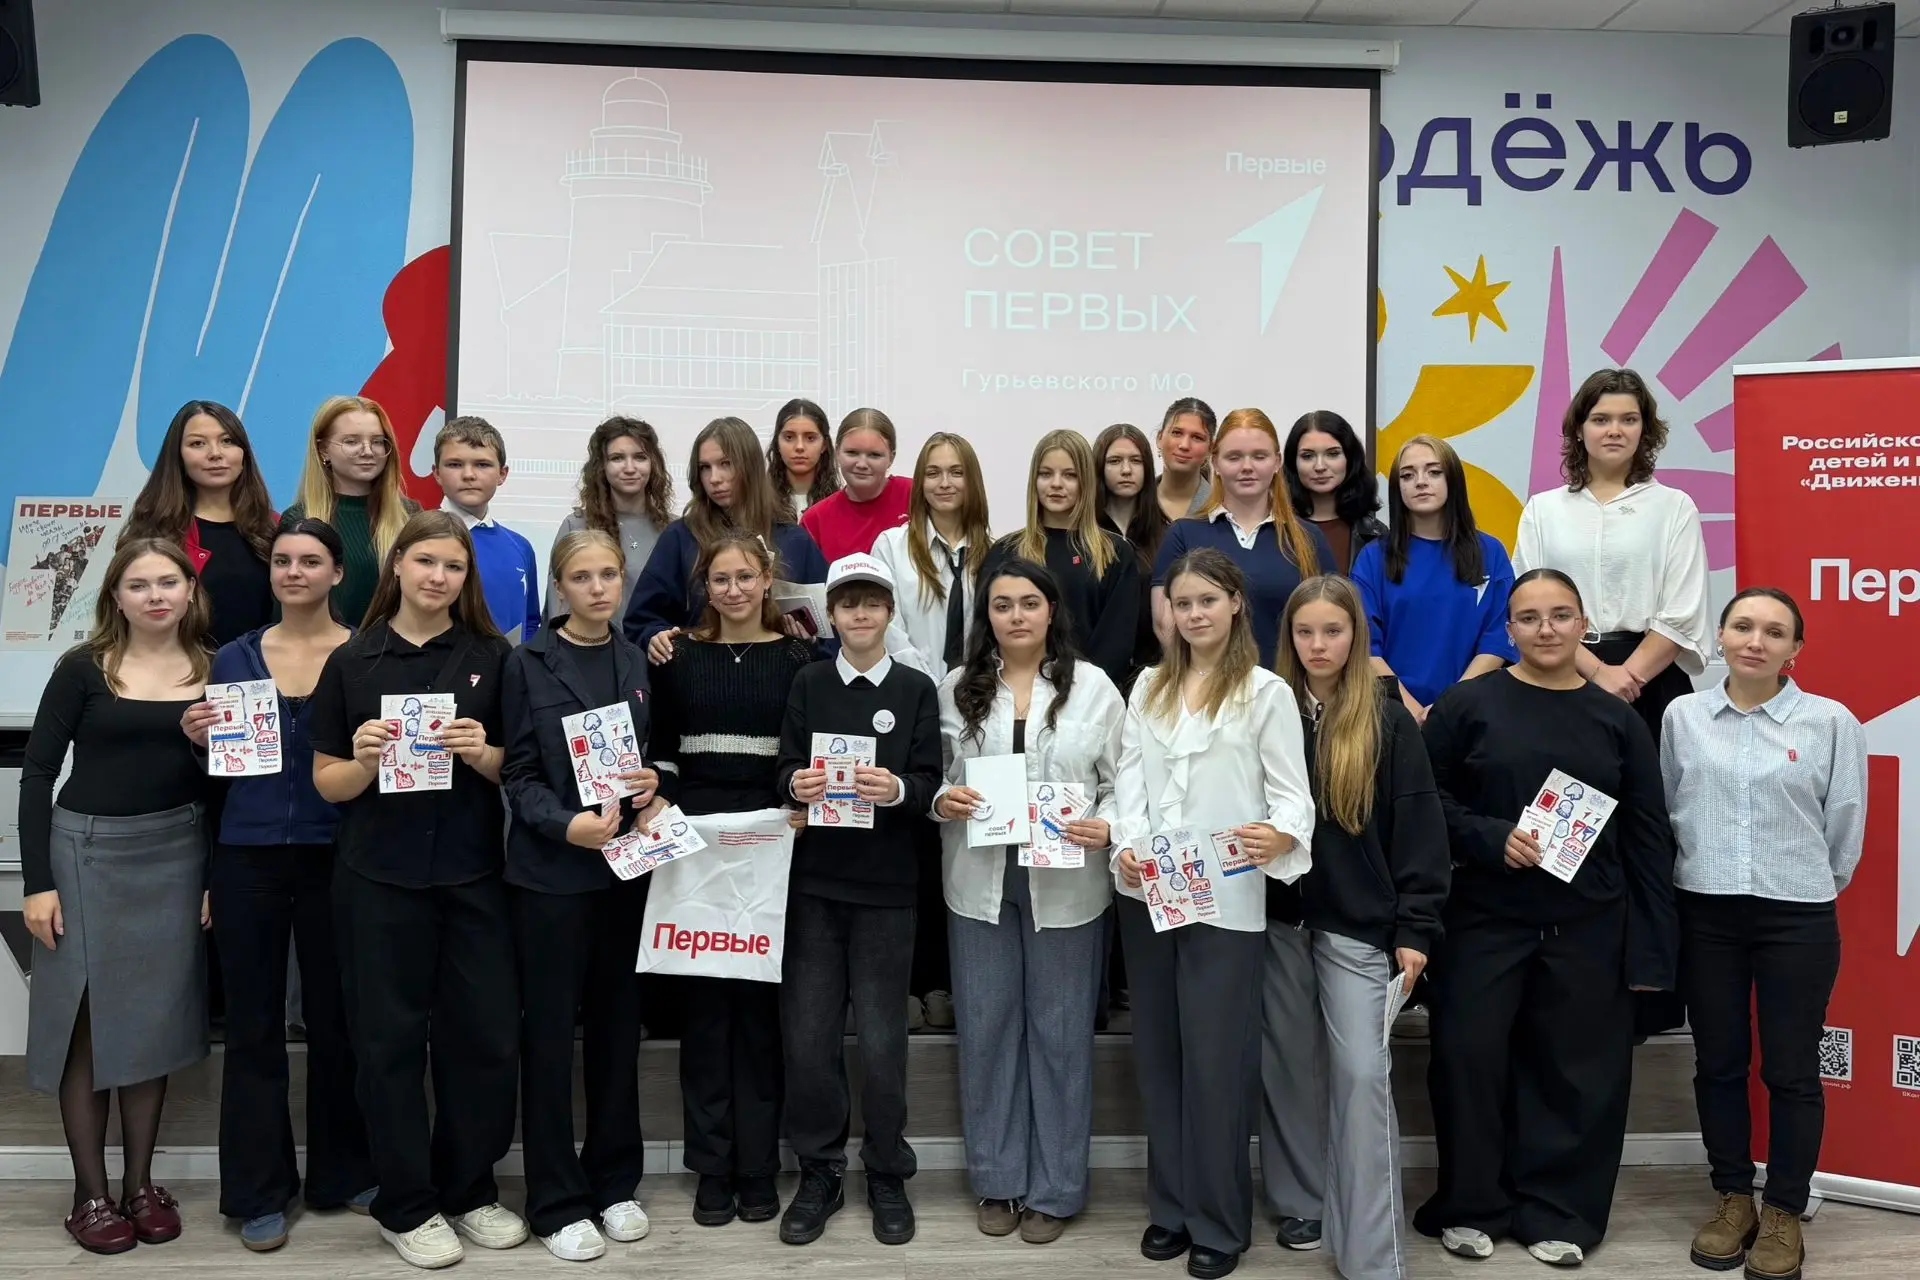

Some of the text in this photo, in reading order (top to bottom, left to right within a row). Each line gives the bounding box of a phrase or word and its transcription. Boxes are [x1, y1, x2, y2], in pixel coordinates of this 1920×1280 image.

[1380, 92, 1753, 206] дёжь
[1225, 151, 1327, 180] Первые
[963, 227, 1155, 271] СОВЕТ
[963, 289, 1200, 334] ПЕРВЫХ
[962, 368, 1195, 395] Гурьевского МО
[1782, 432, 1920, 450] Российско
[1808, 452, 1887, 471] детей
[1893, 456, 1910, 467] и
[1800, 473, 1920, 491] «Движен
[20, 503, 122, 518] ПЕРВЫЕ
[1811, 558, 1920, 617] Пер
[652, 922, 771, 959] Первые
